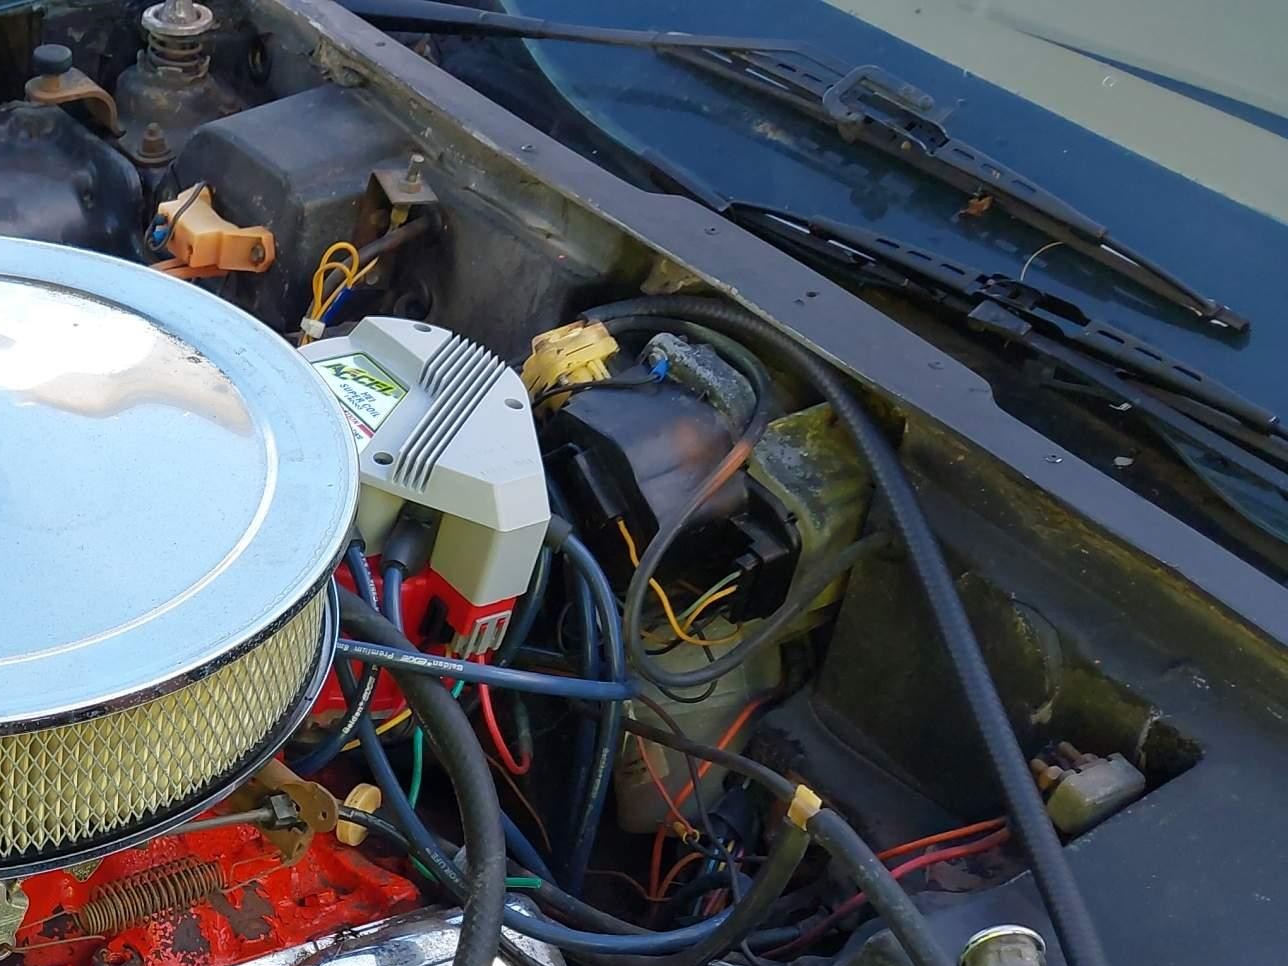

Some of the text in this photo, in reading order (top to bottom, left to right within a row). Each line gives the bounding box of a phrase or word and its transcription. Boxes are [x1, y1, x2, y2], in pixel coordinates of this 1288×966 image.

[319, 363, 394, 397] ACCEL
[339, 383, 381, 418] SUPER COIL
[353, 645, 395, 660] Premium
